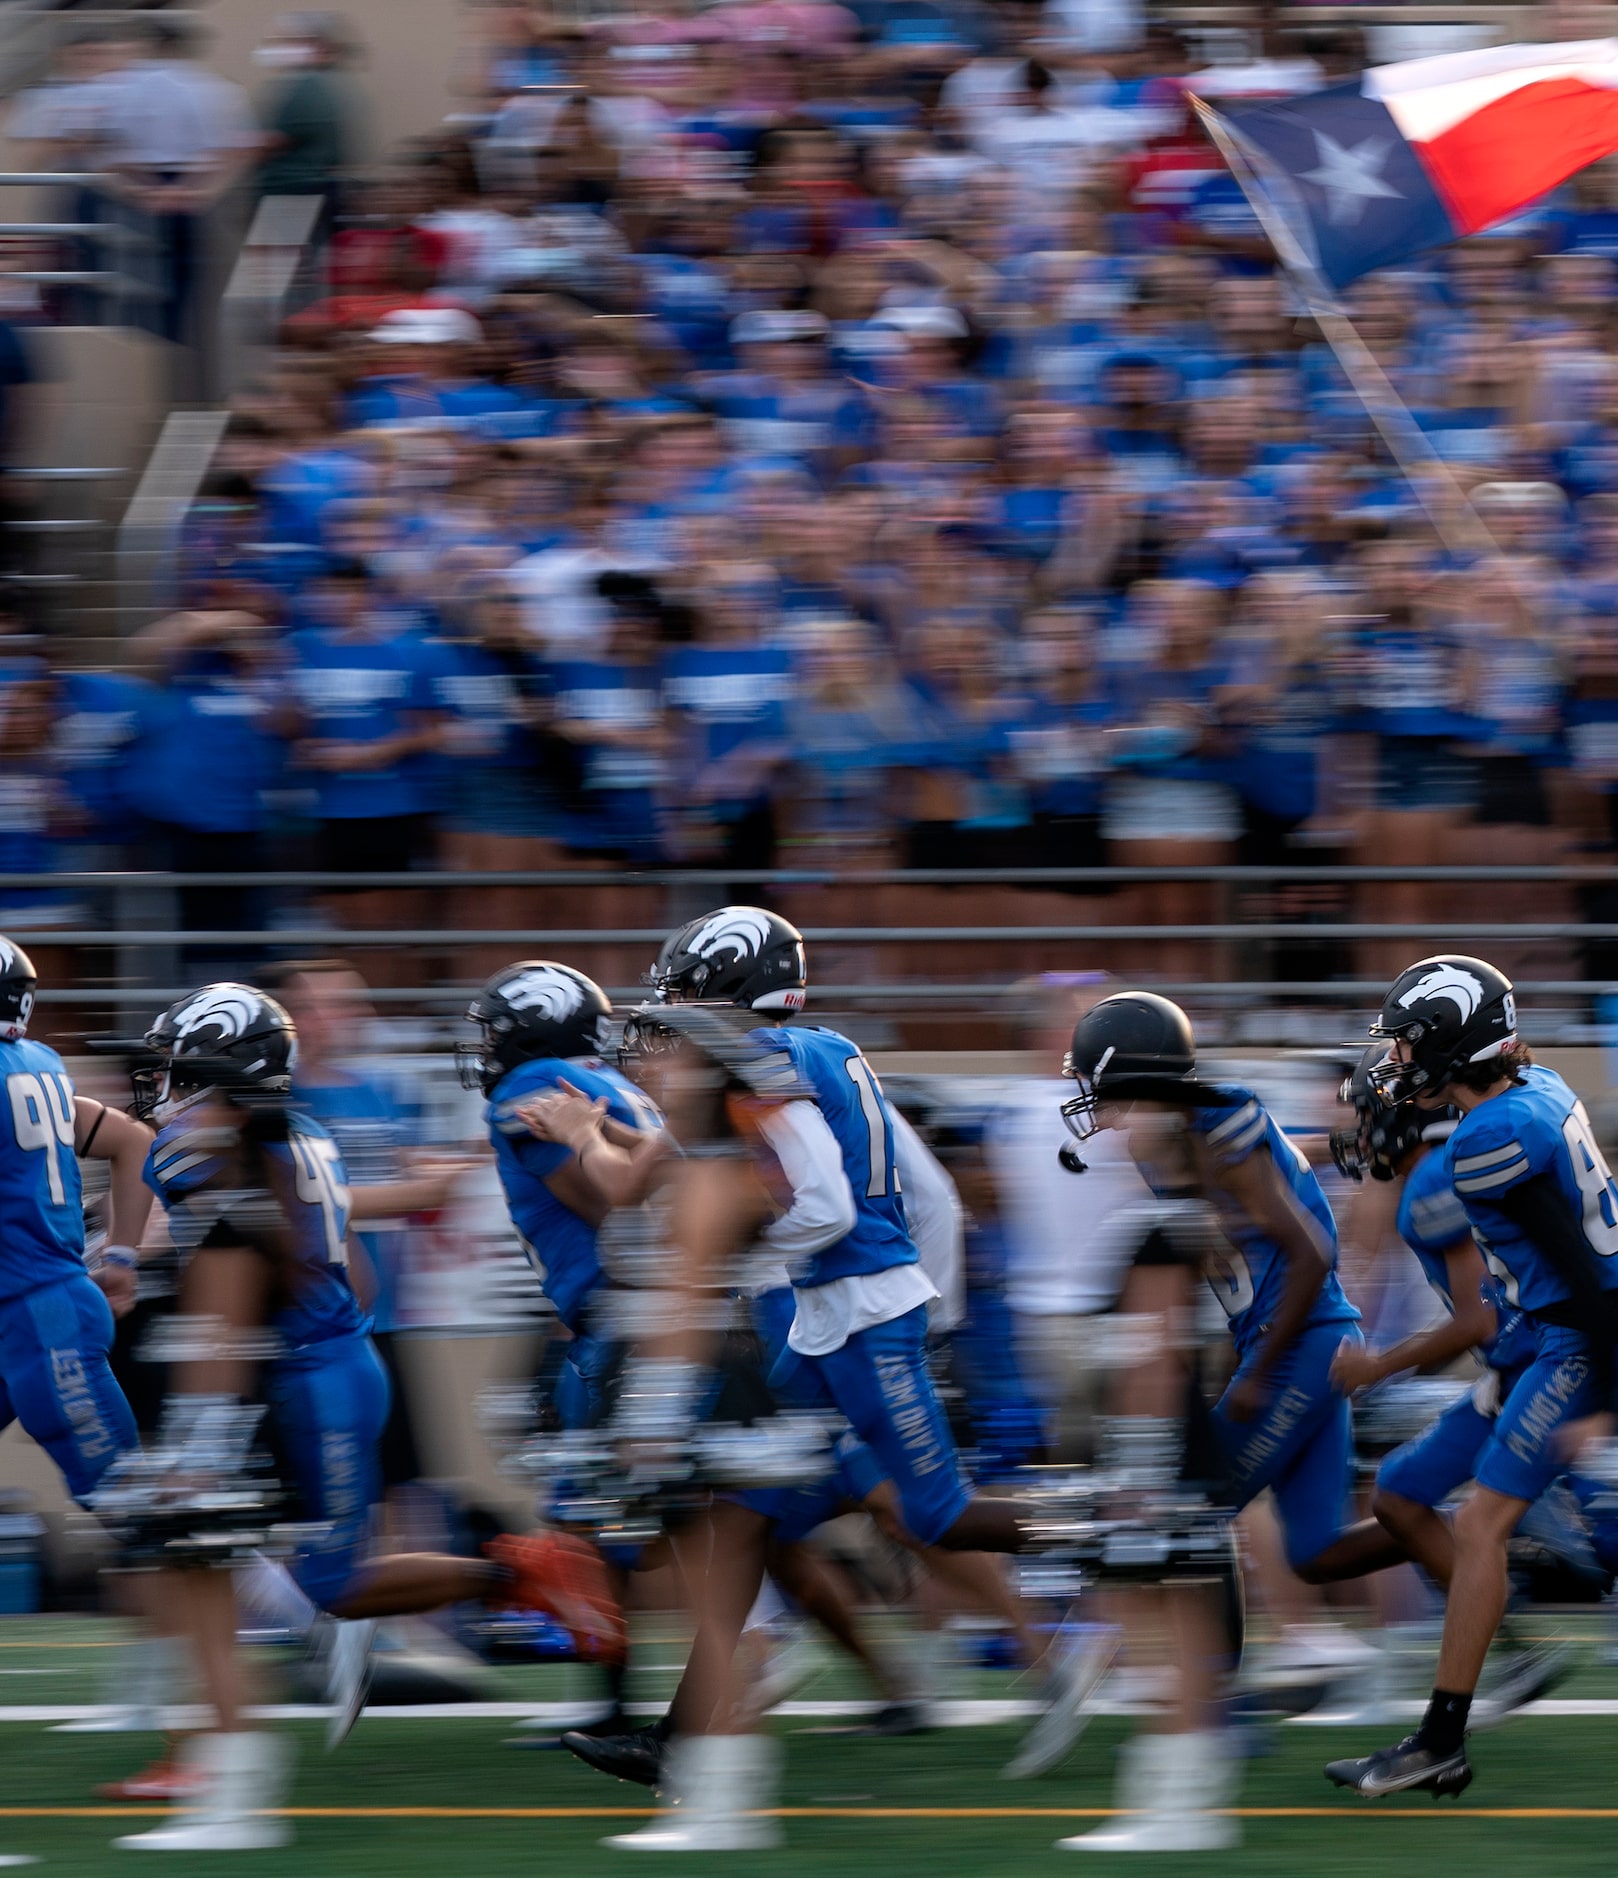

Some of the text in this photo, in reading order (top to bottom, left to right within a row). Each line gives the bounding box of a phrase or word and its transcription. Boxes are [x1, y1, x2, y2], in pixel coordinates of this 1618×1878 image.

[844, 1056, 902, 1199] 1
[873, 1354, 946, 1478] PLANO WEST
[1228, 1432, 1281, 1482] LANO
[1505, 1390, 1563, 1465] PLANO
